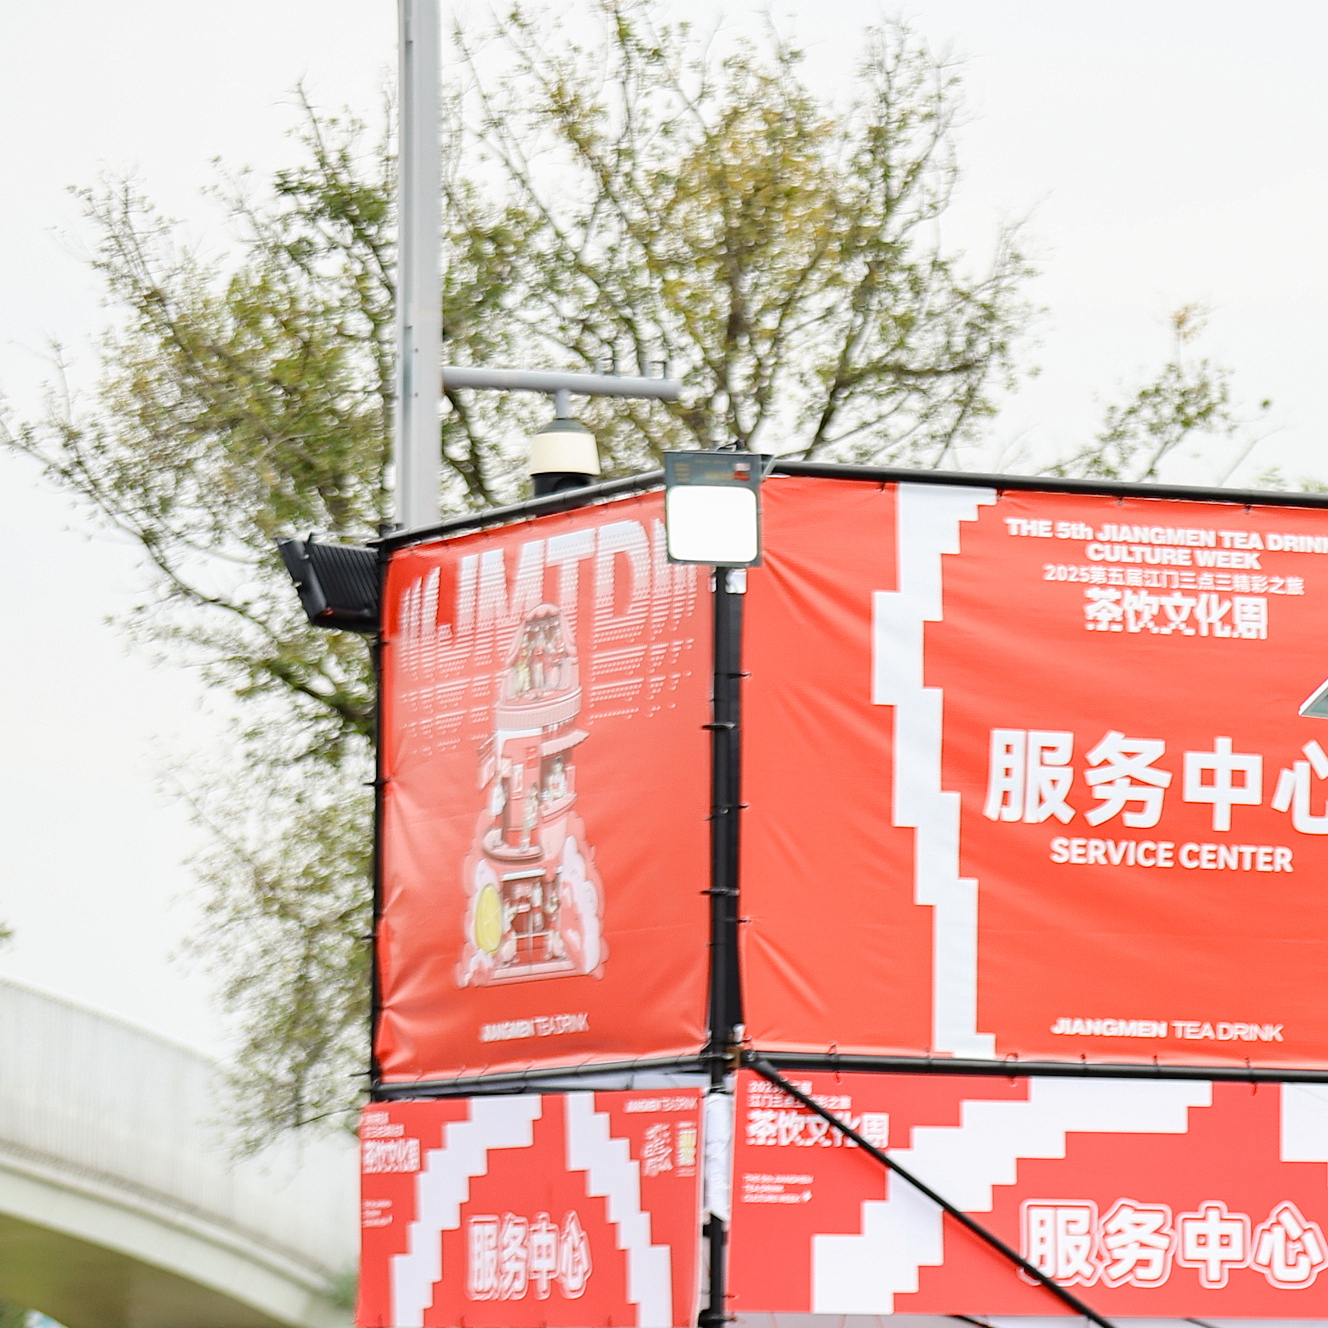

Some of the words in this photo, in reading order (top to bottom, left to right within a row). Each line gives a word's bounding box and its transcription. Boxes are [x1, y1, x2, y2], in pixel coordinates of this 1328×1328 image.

[1005, 518, 1052, 538] THE
[1057, 522, 1093, 540] 5th
[1097, 525, 1216, 548] JIANGMEN
[1219, 531, 1263, 550] TEA
[1086, 544, 1191, 567] CULTURE
[1195, 549, 1261, 570] WEEK
[1084, 588, 1268, 639] 茶饮文化周
[1050, 838, 1174, 868] SERVICE
[1179, 843, 1294, 872] CENTER
[1051, 1018, 1167, 1039] JIANGMEN
[1171, 1020, 1214, 1040] TEA
[1215, 1022, 1285, 1042] DRINK
[1024, 1203, 1326, 1285] 服务中心
